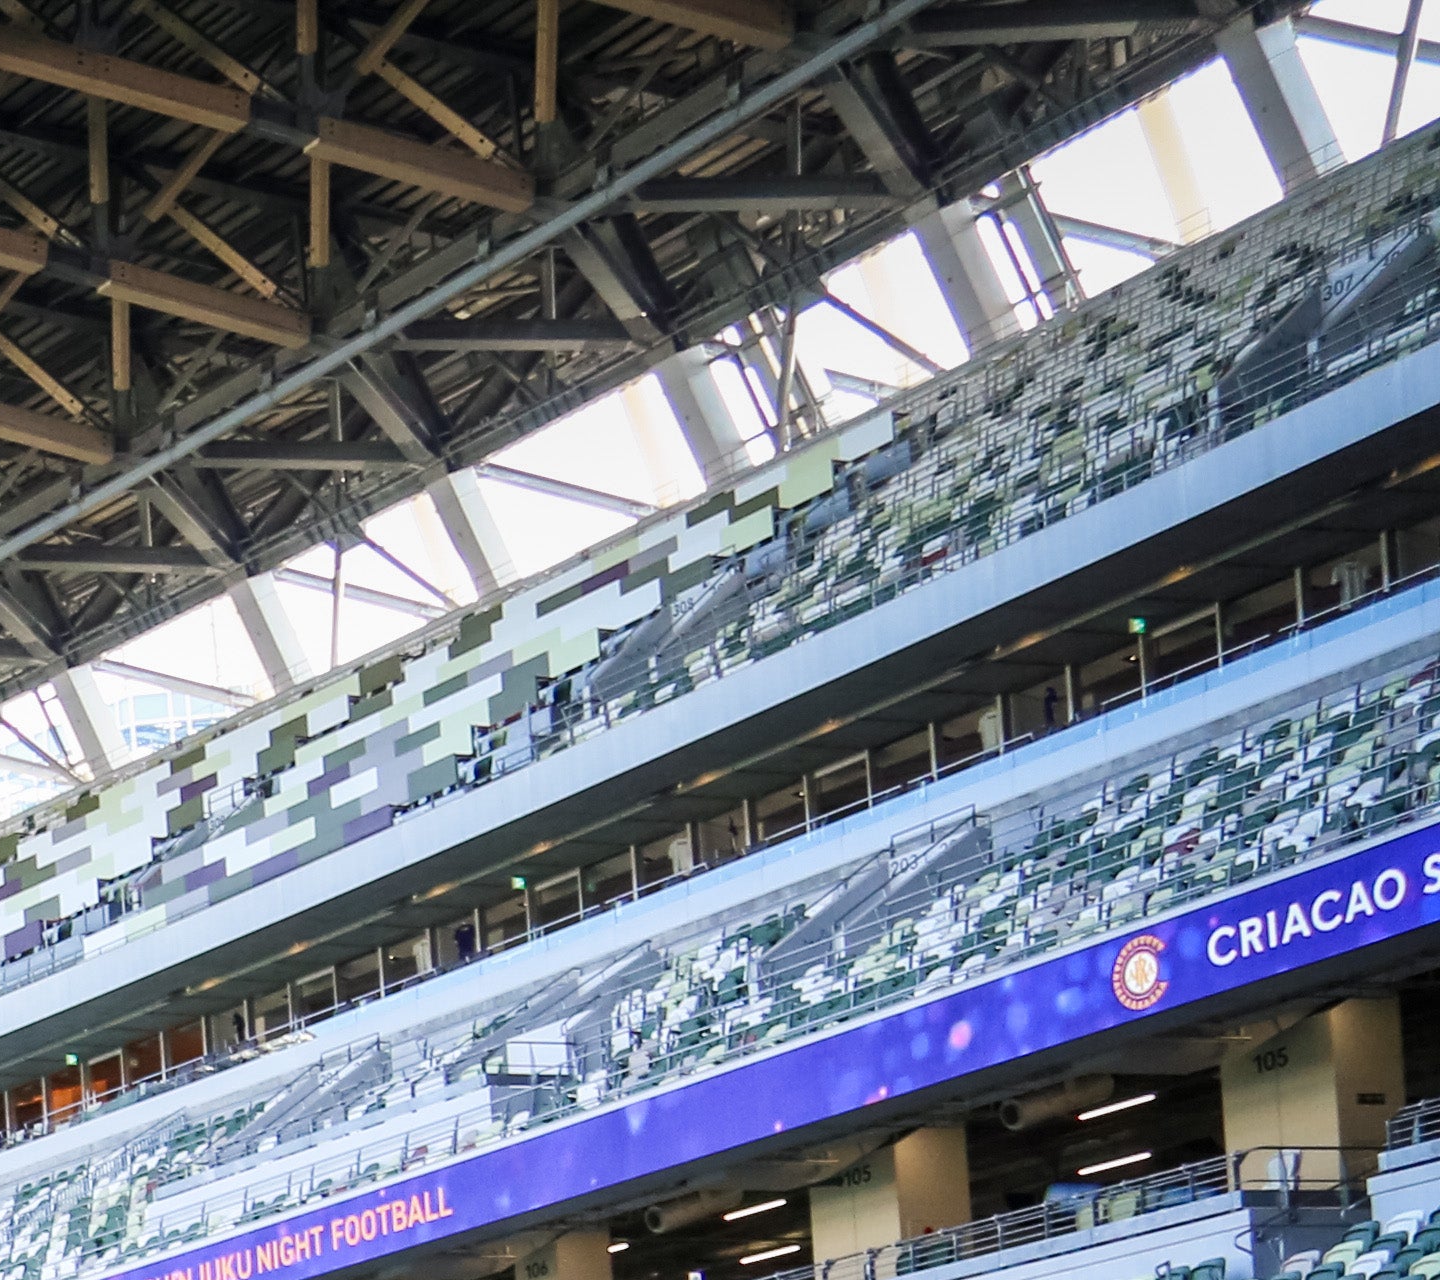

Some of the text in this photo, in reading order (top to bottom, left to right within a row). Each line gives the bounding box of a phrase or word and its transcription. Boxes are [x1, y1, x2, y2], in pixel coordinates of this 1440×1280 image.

[890, 854, 918, 878] 203
[1206, 868, 1407, 967] CRIACAO
[1253, 1047, 1289, 1074] 105
[843, 1165, 872, 1188] 105
[256, 1225, 324, 1274] NIGHT
[331, 1186, 454, 1251] FOOTBALL
